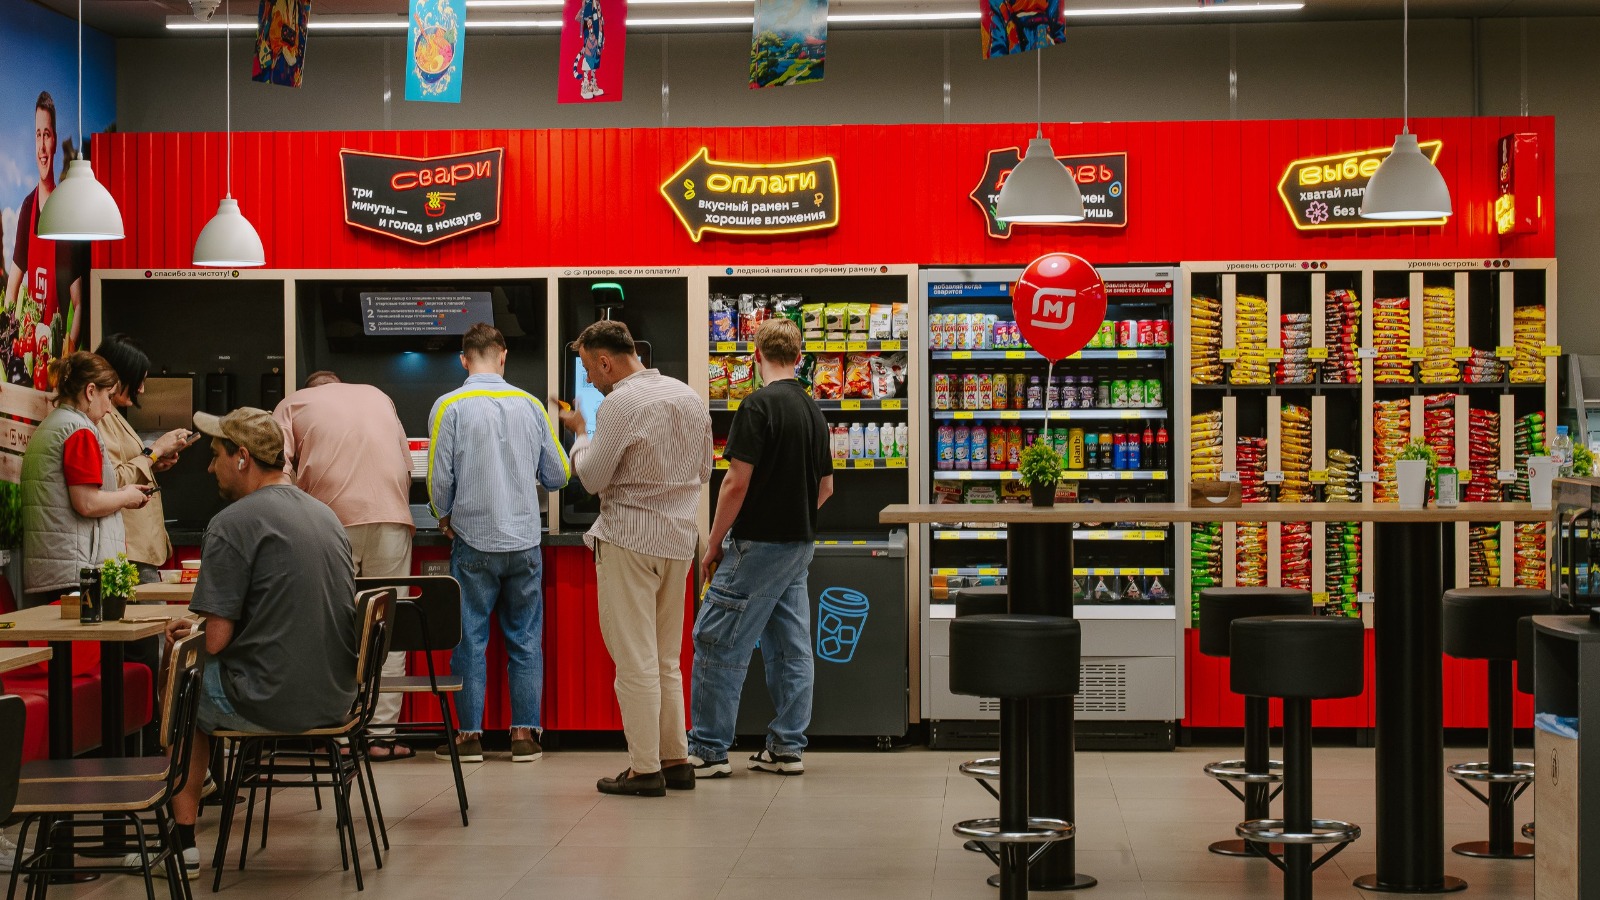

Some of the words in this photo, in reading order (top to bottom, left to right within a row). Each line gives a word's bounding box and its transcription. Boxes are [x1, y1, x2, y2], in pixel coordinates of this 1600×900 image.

[352, 187, 373, 199] три
[1299, 187, 1342, 202] хватай
[351, 200, 395, 215] минуты
[698, 199, 749, 212] вкусный
[751, 201, 790, 214] рамен
[1333, 205, 1355, 217] без
[378, 218, 387, 227] и
[388, 219, 423, 235] голод
[427, 223, 434, 233] в
[435, 211, 482, 231] нокауте
[704, 212, 762, 226] хорошие
[764, 210, 827, 226] вложения
[154, 270, 187, 278] спасибо
[197, 270, 230, 278] чистоту!
[737, 267, 770, 275] ледяной
[810, 266, 847, 274] горячему
[848, 266, 877, 275] рамену
[366, 297, 373, 306] 1
[367, 309, 374, 319] 2
[369, 322, 376, 331] 3
[1073, 447, 1082, 464] plan
